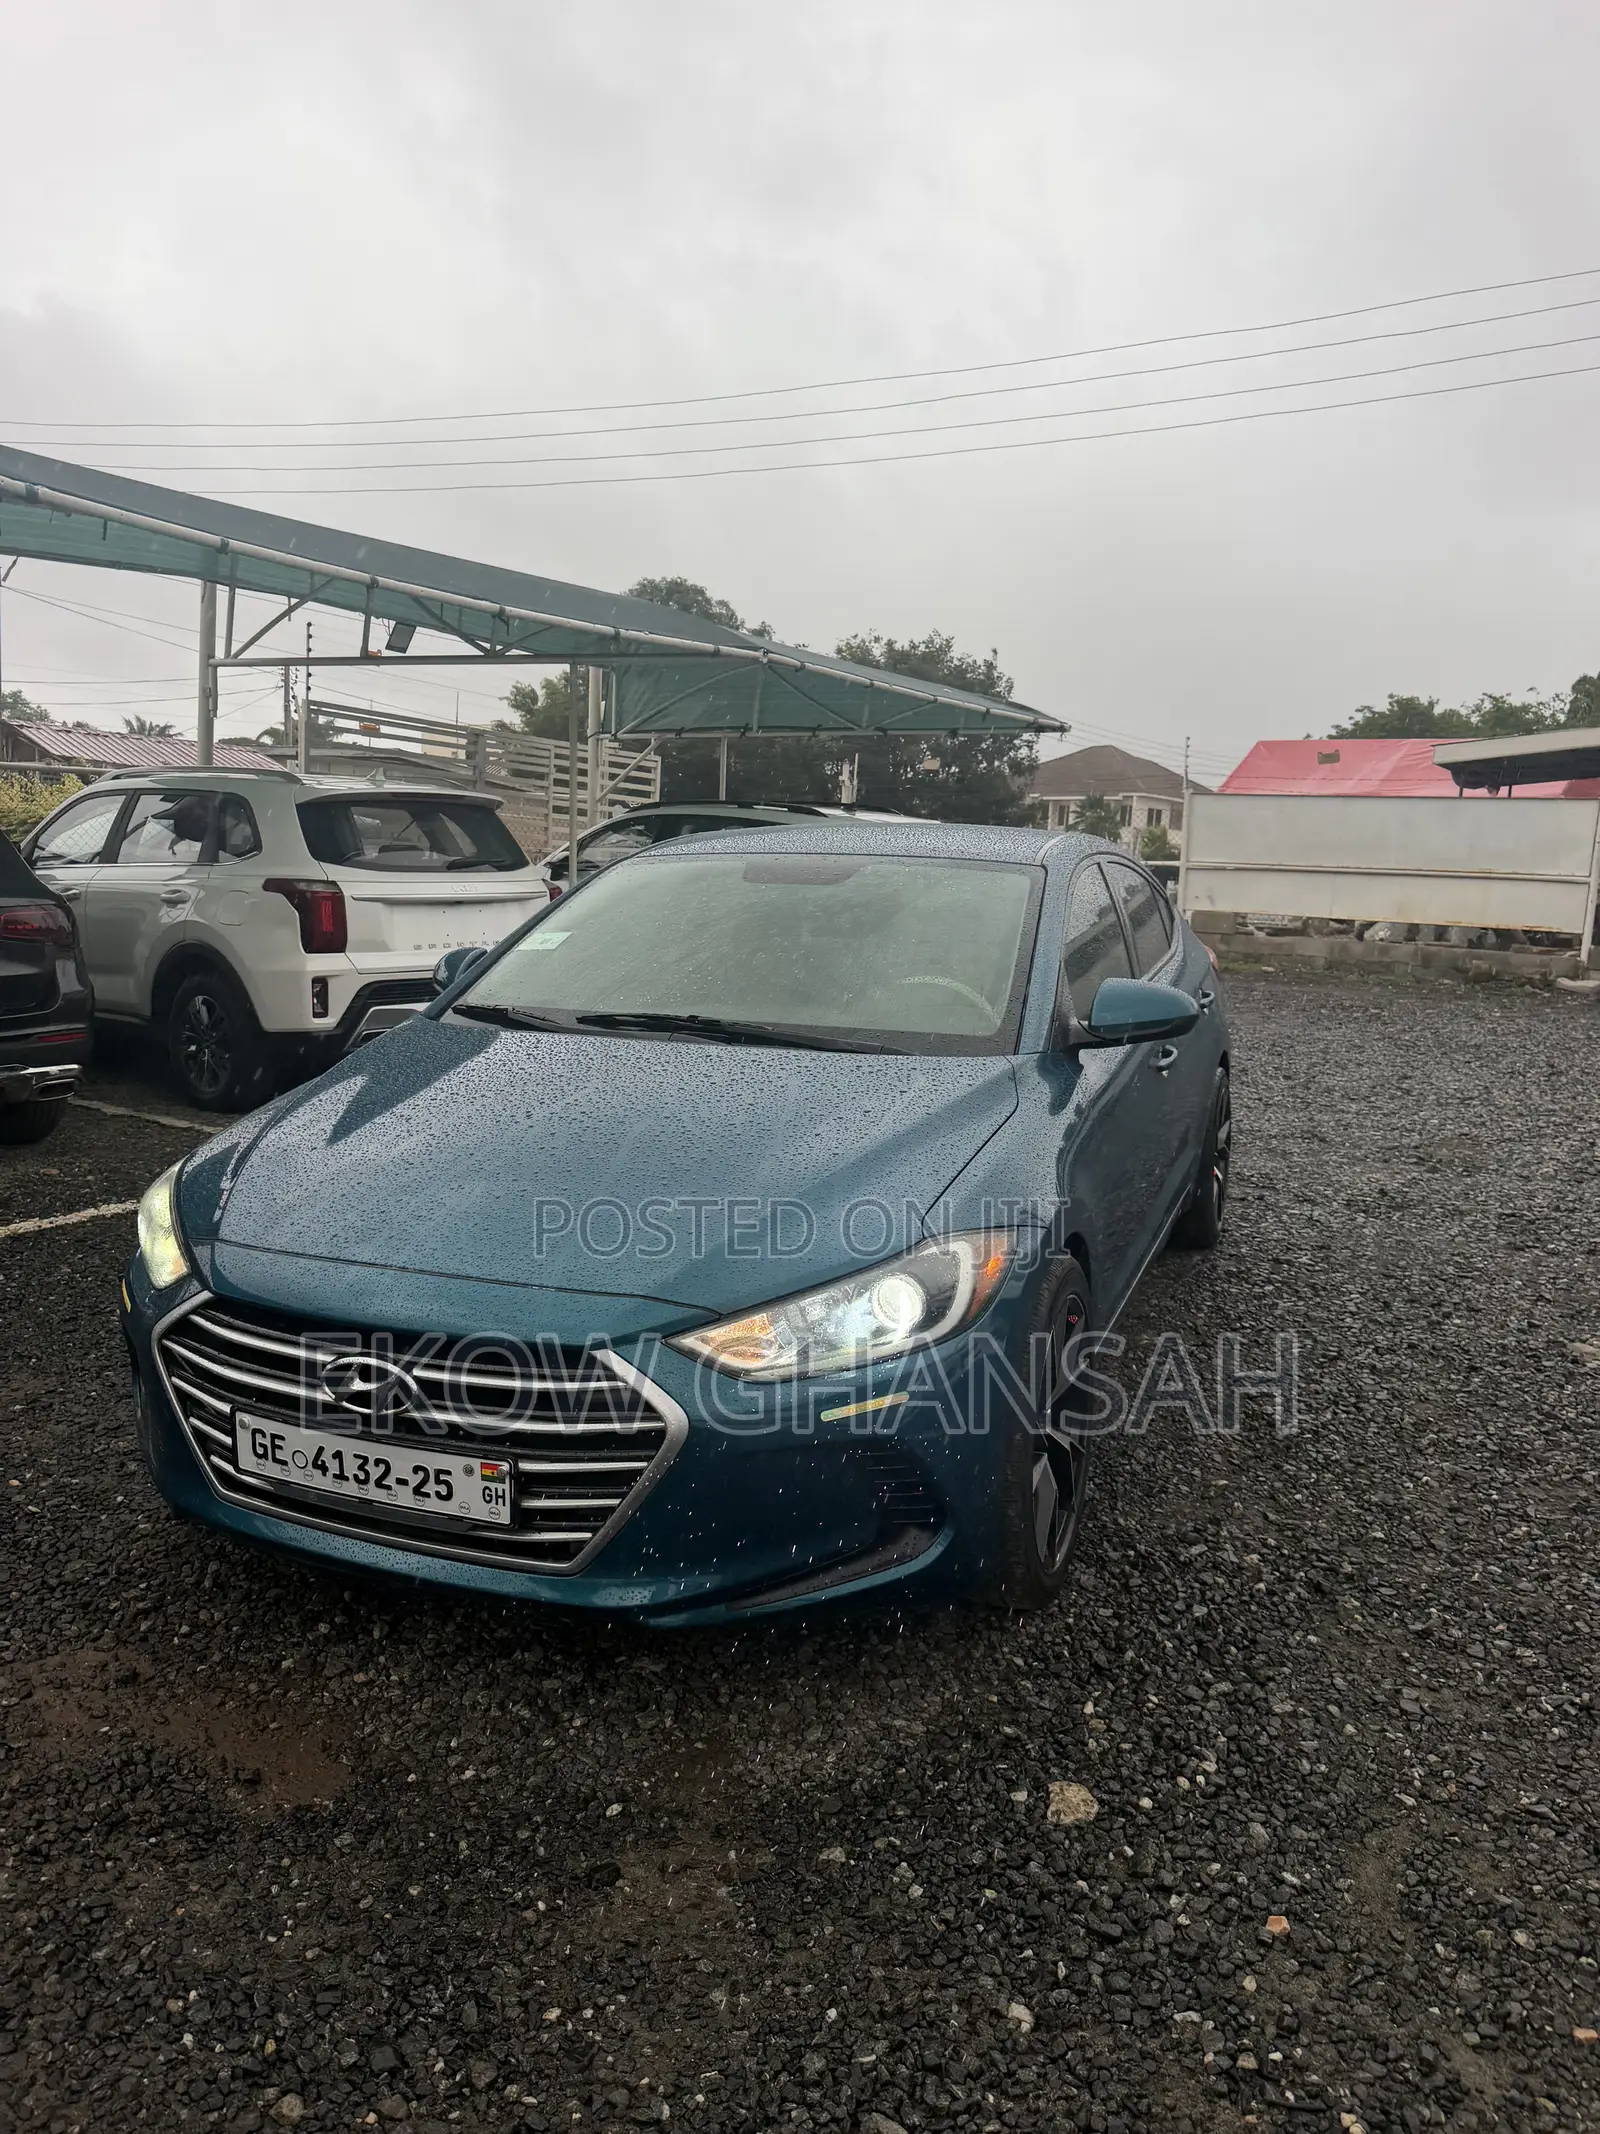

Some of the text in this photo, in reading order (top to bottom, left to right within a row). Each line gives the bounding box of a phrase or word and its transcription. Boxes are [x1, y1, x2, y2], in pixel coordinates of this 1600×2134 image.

[251, 1428, 454, 1502] GE 4132-25
[482, 1486, 506, 1507] GH
